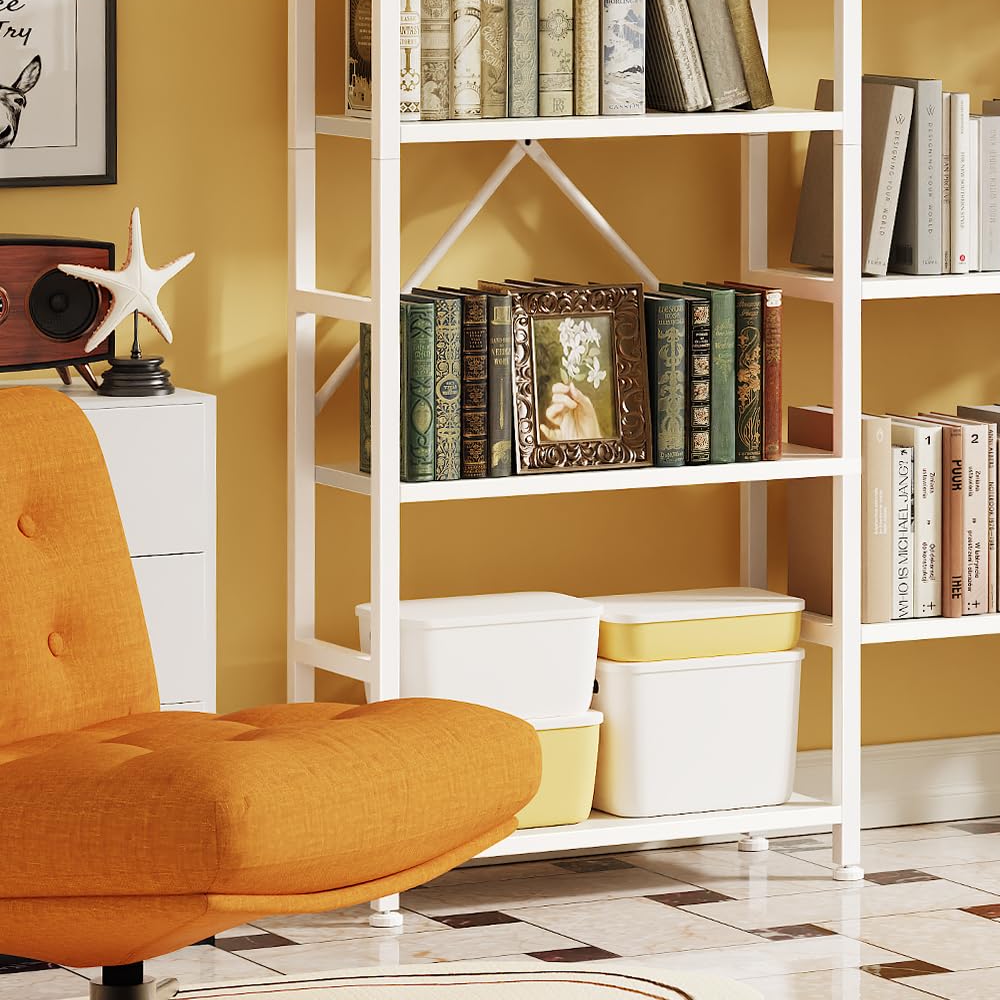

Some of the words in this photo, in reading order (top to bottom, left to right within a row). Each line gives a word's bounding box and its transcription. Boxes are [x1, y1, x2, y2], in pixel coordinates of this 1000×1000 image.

[924, 435, 931, 446] 1
[970, 433, 979, 444] 2
[898, 460, 909, 502] JANG?
[898, 503, 909, 566] MICHAEL
[898, 567, 909, 580] IS
[898, 582, 909, 618] WHO
